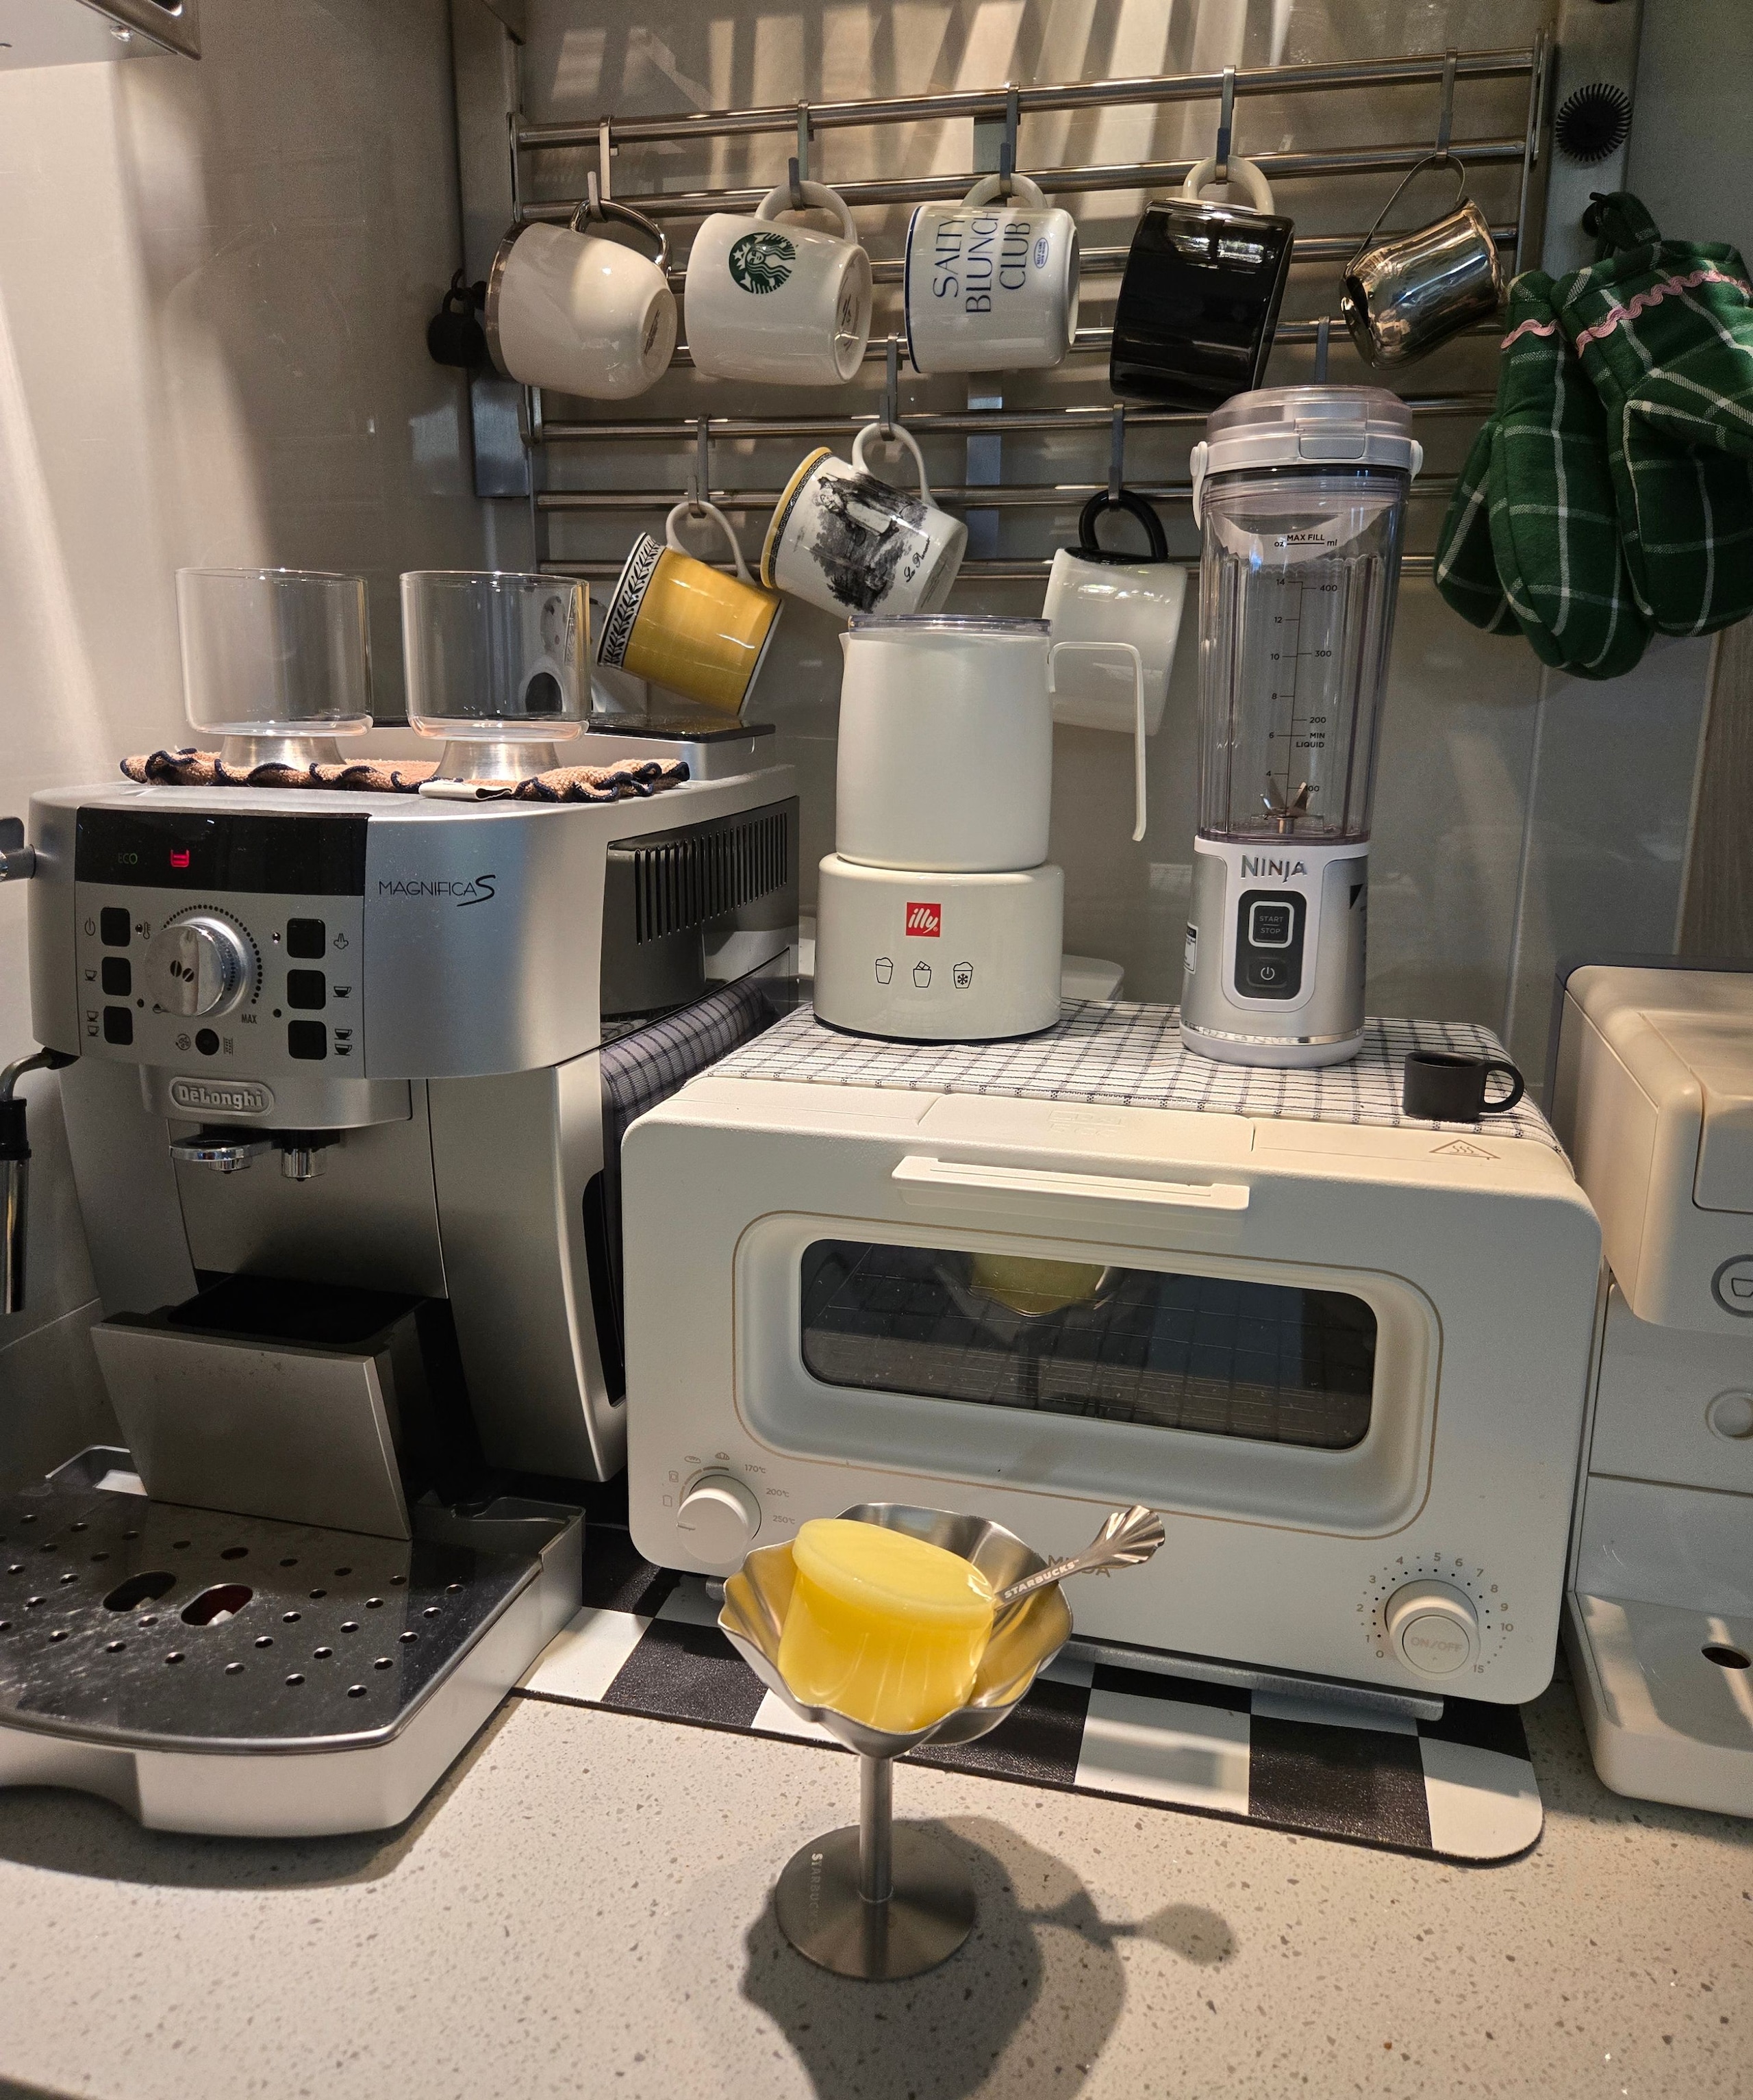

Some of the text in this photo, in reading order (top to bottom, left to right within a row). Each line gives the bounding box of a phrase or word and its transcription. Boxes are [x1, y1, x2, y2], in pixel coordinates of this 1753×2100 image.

[932, 215, 966, 298] SALTY
[999, 223, 1031, 290] CLUB
[966, 211, 1002, 313] BLUNCH
[1327, 538, 1337, 546] ml
[118, 852, 138, 865] ECO
[1240, 854, 1308, 883] NINJA
[241, 1013, 257, 1025] MAX
[1396, 1556, 1404, 1565] 4
[1433, 1552, 1441, 1562] 5
[1454, 1558, 1463, 1567] 6
[1476, 1568, 1484, 1577] 7
[1370, 1575, 1376, 1584] 3
[1490, 1584, 1498, 1593] 8
[1357, 1604, 1364, 1612] 2
[1500, 1603, 1509, 1612] 9
[1500, 1623, 1514, 1632] 10
[1411, 1637, 1463, 1652] ON/OFF
[1376, 1649, 1384, 1658] 0
[1473, 1665, 1485, 1673] 15
[809, 1852, 823, 1916] STARBUC
